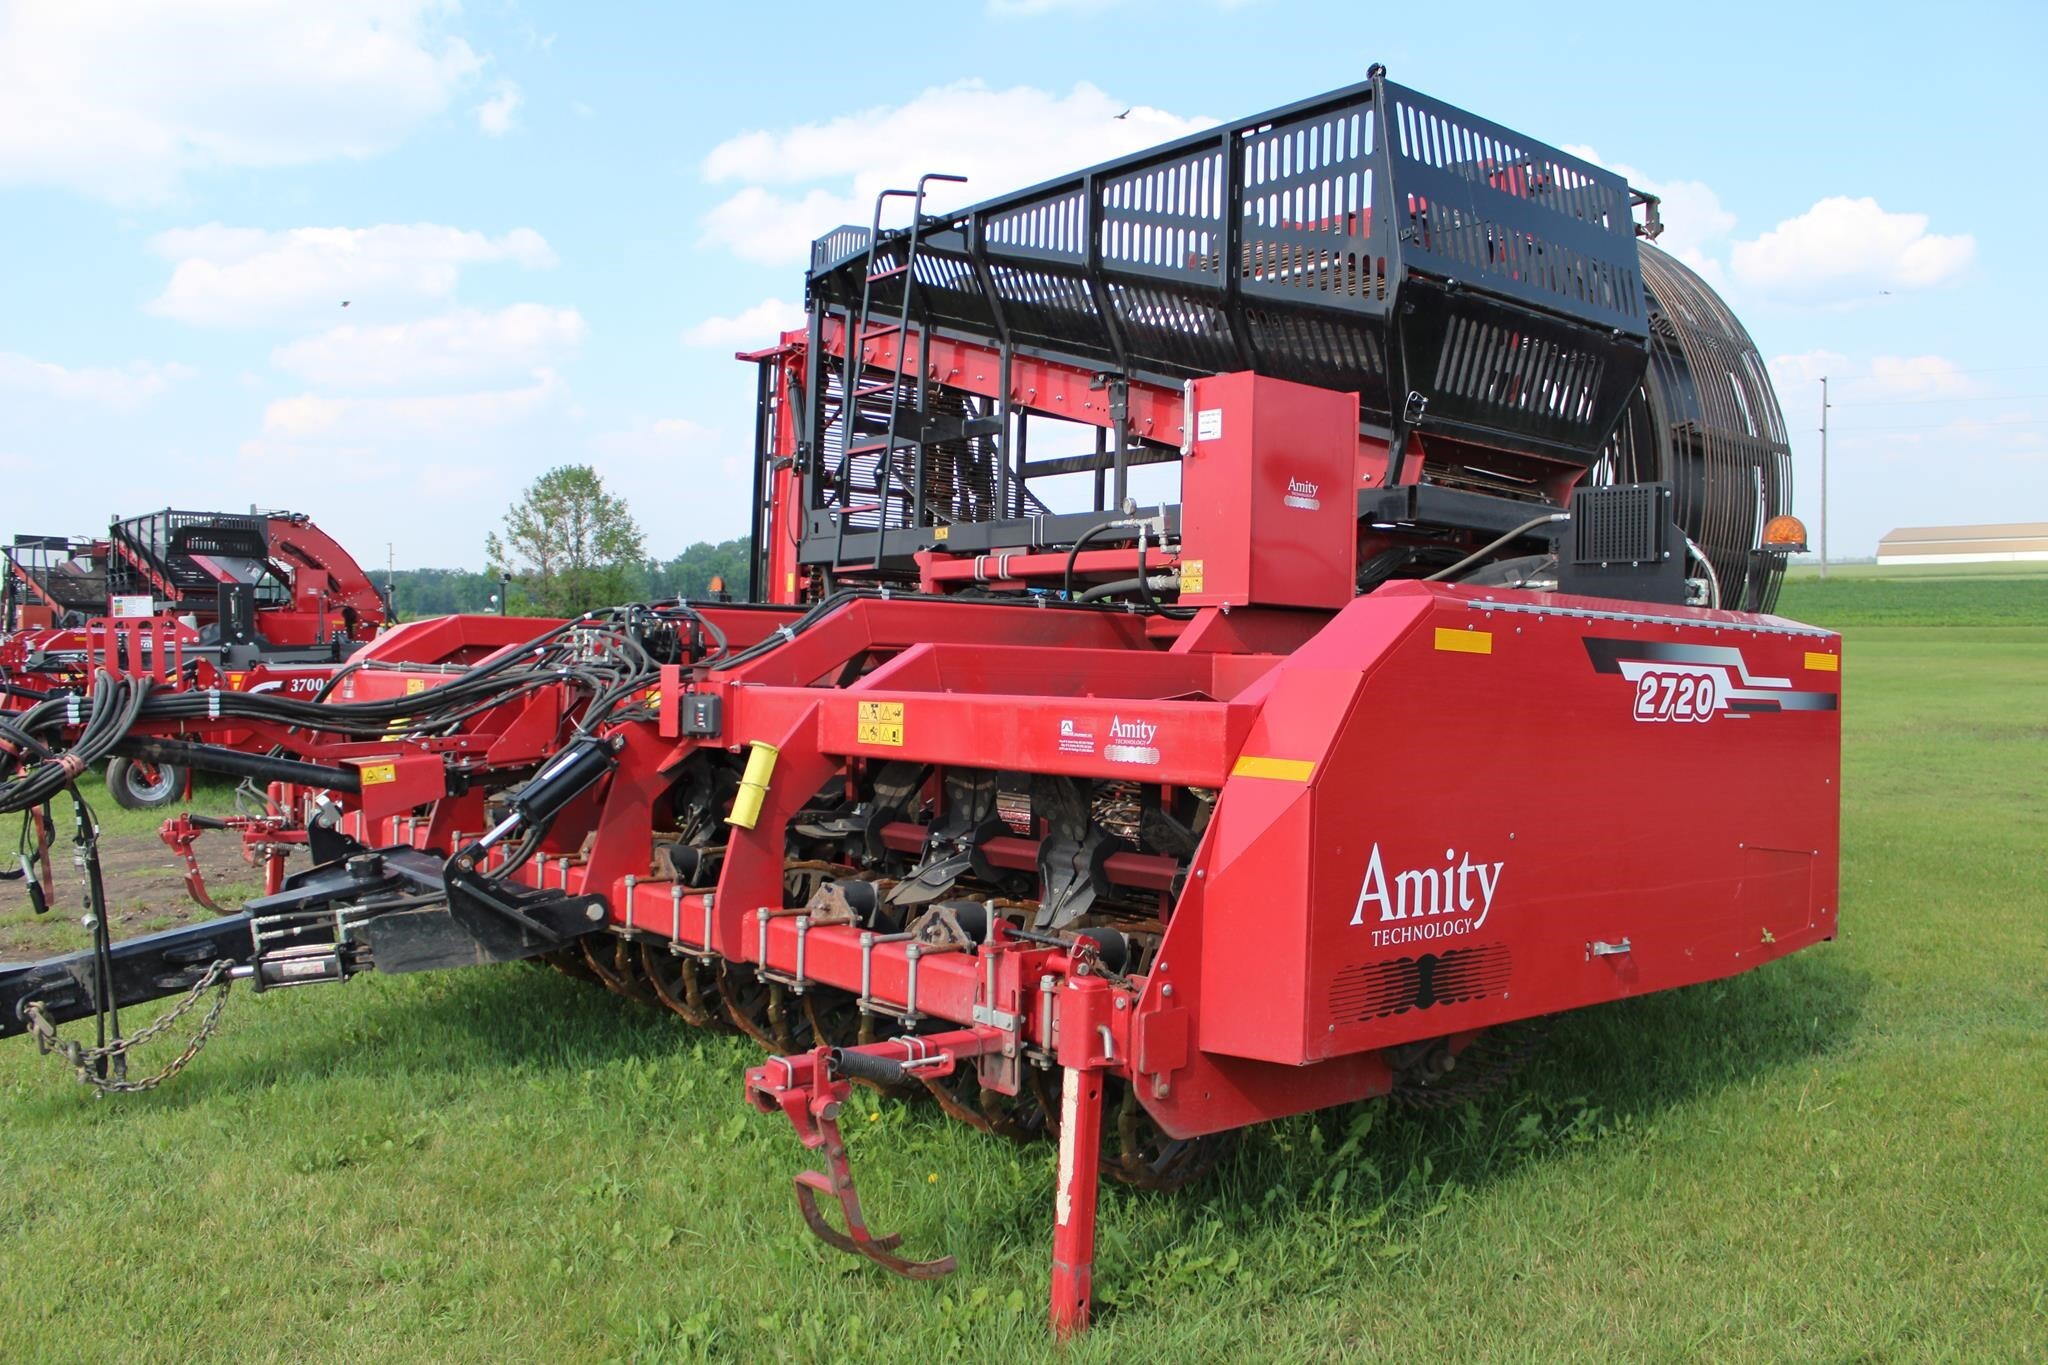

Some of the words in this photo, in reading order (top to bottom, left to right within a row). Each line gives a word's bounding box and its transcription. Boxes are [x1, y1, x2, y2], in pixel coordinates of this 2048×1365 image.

[1287, 476, 1319, 498] Amity
[290, 678, 324, 692] 3700
[1637, 675, 1714, 715] 2720
[1109, 715, 1158, 745] Amity
[1350, 842, 1504, 930] Amity
[1371, 918, 1472, 947] TECHNOLOGY
